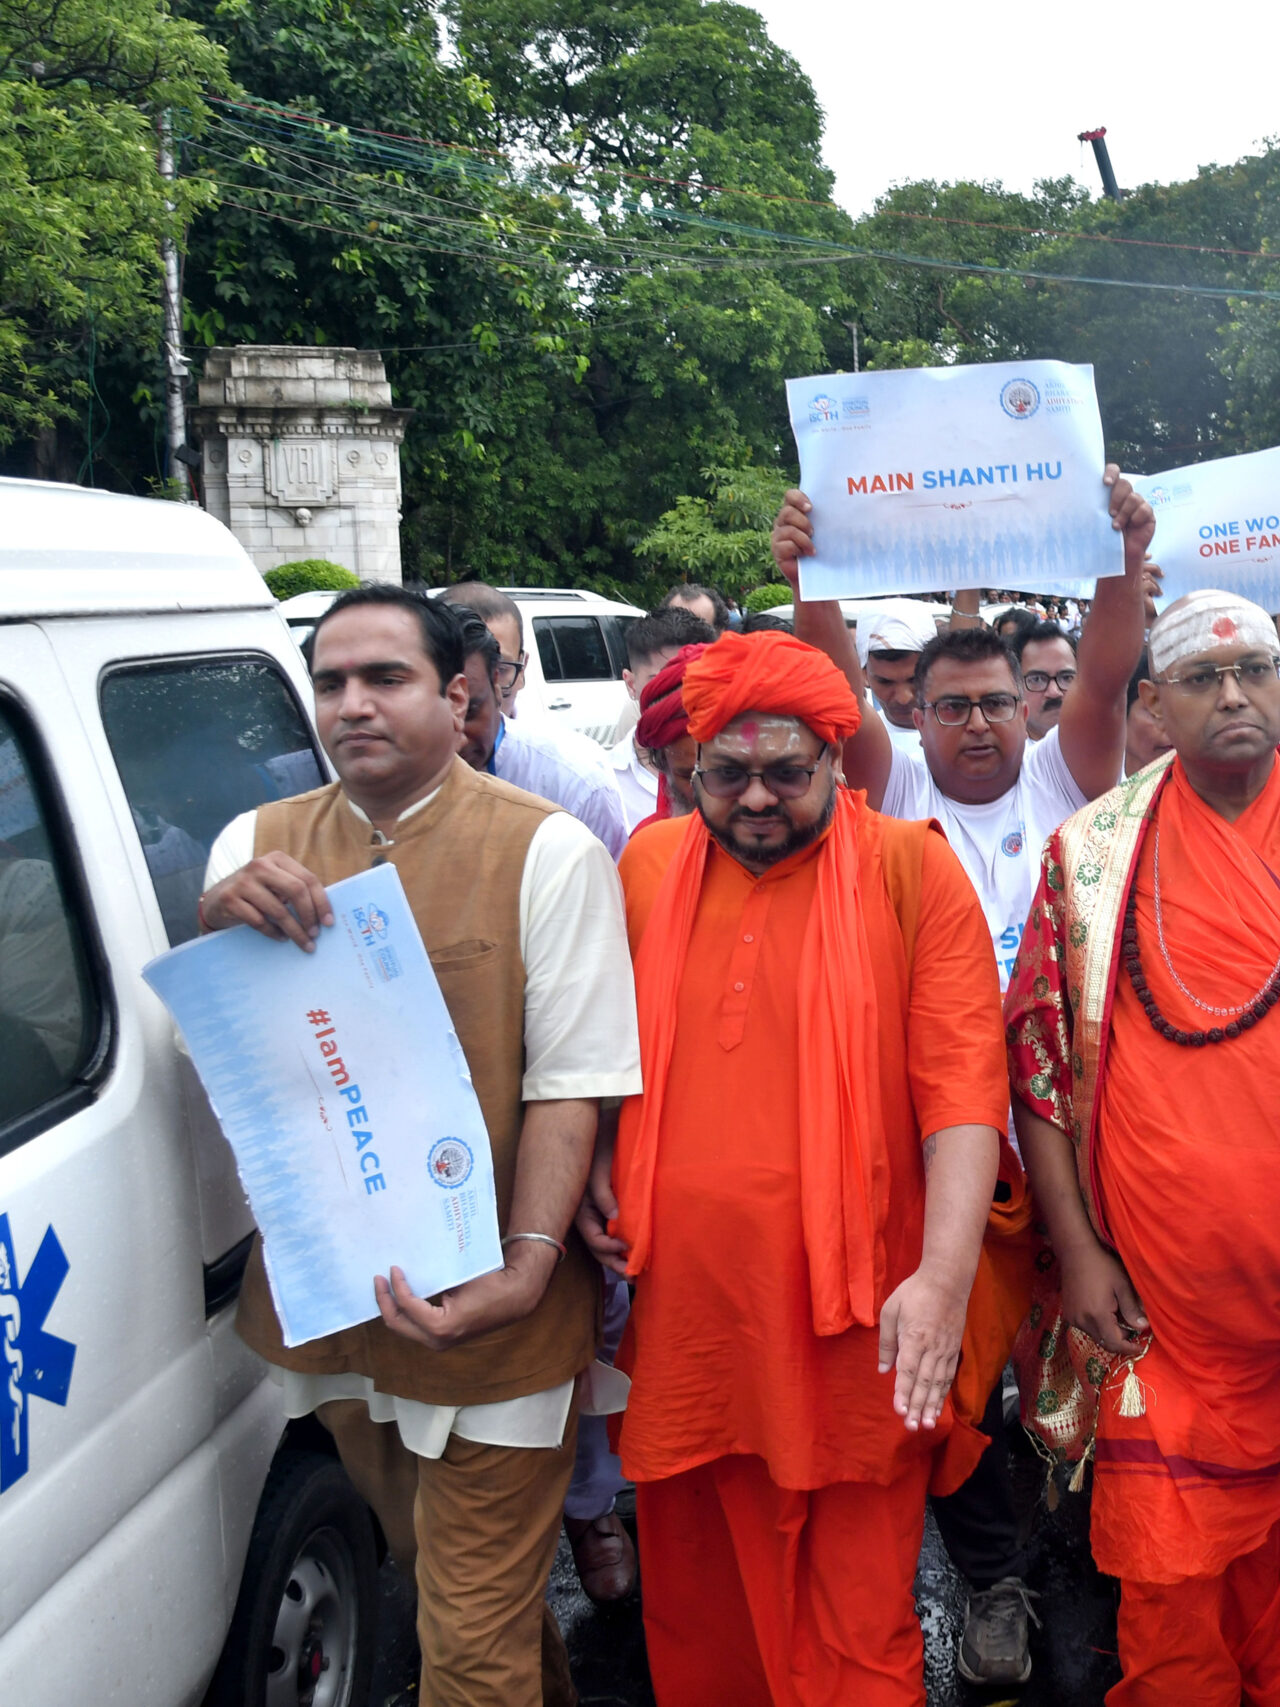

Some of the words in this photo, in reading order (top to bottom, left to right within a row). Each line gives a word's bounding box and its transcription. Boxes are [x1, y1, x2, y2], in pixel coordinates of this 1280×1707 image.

[847, 473, 914, 495] MAIN
[922, 465, 1018, 489] SHANTI
[1026, 461, 1063, 481] HU
[1199, 521, 1240, 540] ONE
[1199, 538, 1241, 558] ONE
[306, 1009, 387, 1196] #IamPEACE
